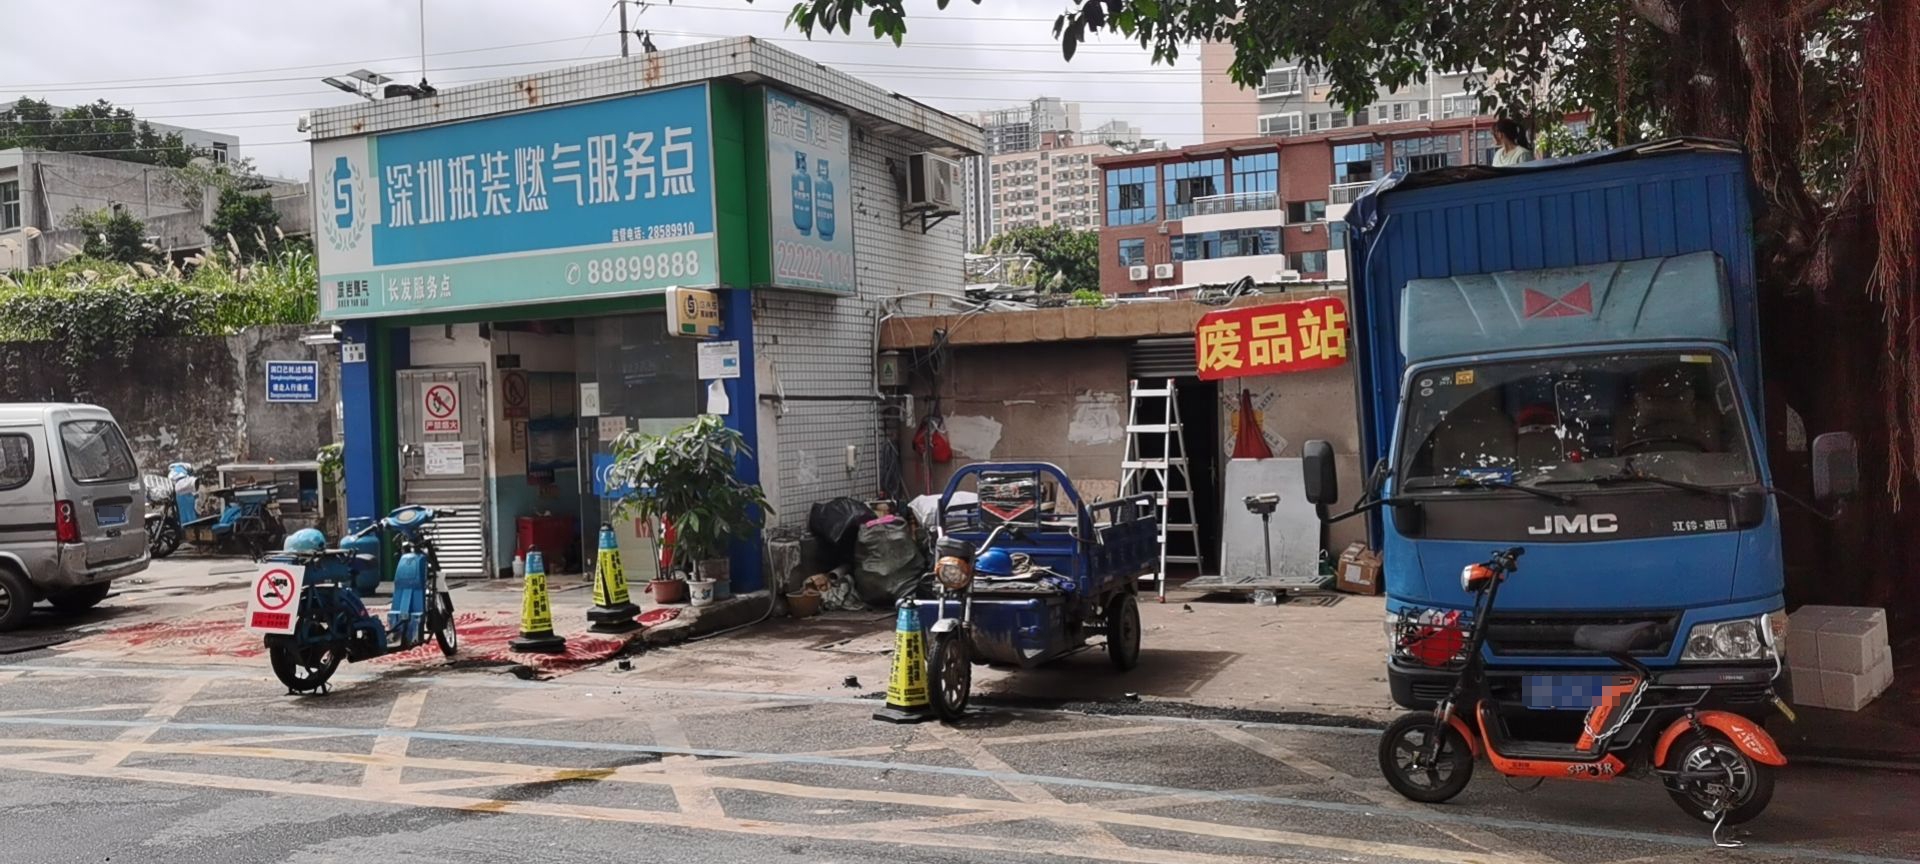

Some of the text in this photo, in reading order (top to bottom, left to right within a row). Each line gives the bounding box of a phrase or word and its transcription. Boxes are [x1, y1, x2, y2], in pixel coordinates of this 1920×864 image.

[386, 126, 696, 227] 深圳瓶装燃气服务点
[588, 250, 699, 284] 88899888
[388, 273, 452, 302] 长发服务点
[1198, 305, 1346, 372] 废品站
[1528, 514, 1618, 534] JMC
